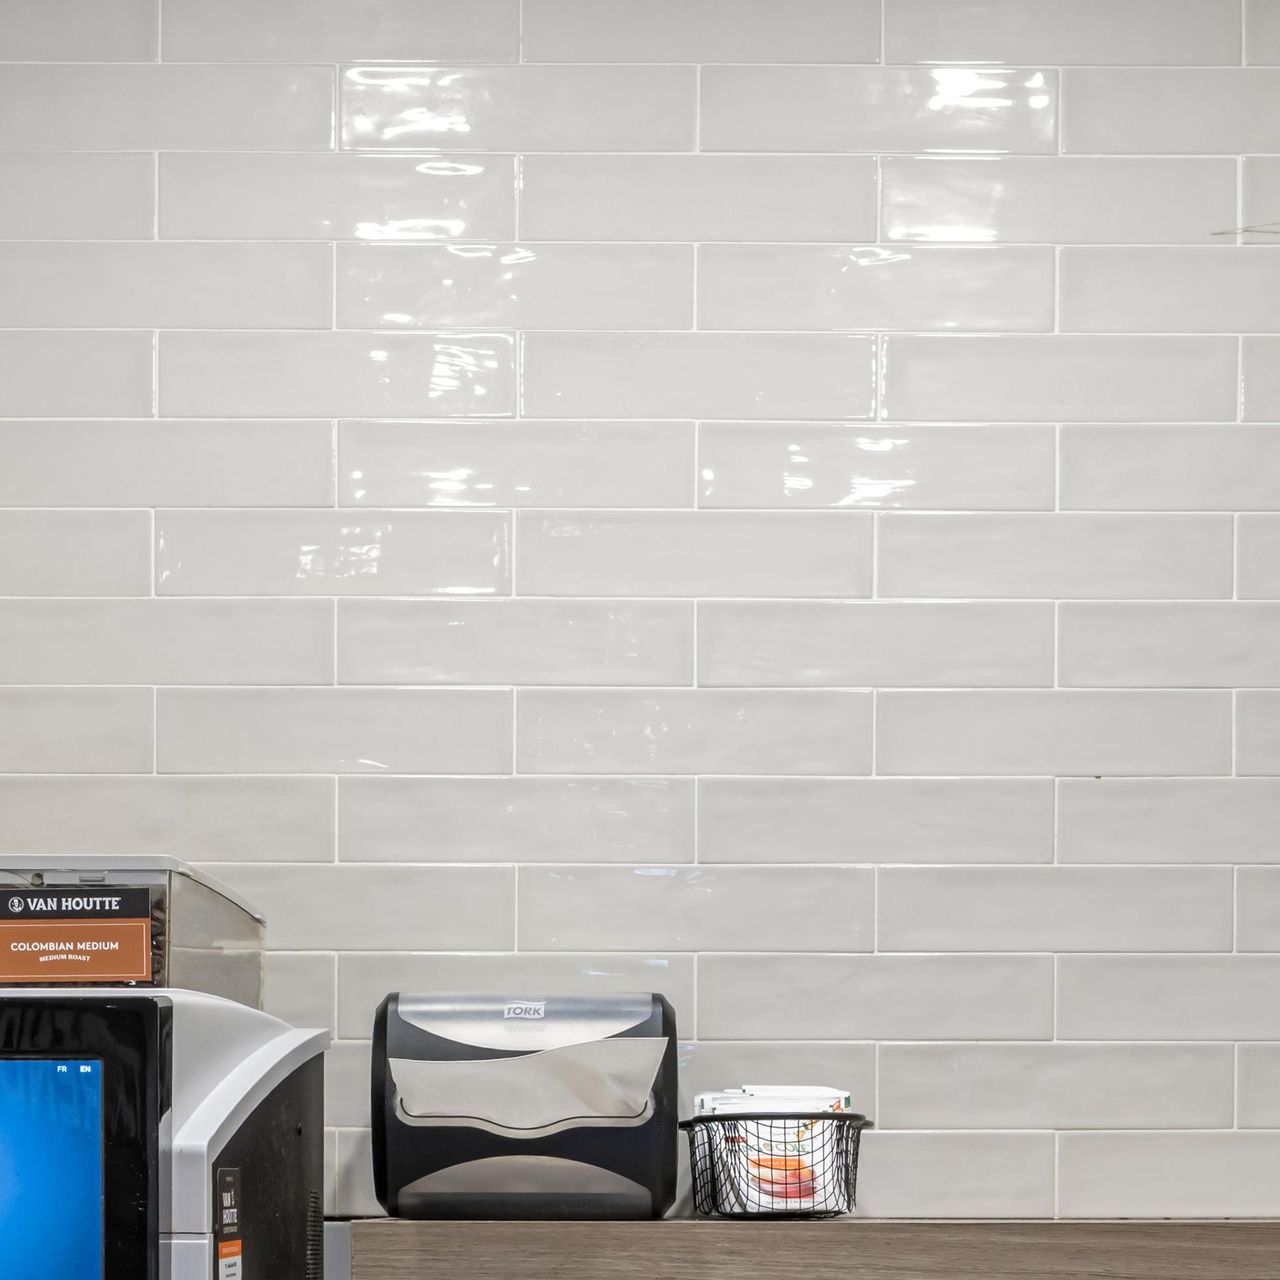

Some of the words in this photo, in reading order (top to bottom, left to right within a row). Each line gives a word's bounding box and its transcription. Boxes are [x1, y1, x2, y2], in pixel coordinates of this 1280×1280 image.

[27, 897, 57, 911] VAN
[61, 897, 120, 910] HOUTTE
[10, 942, 74, 951] COLOMBIAN
[77, 941, 119, 950] MEDIUM
[39, 954, 67, 962] MEDIUM
[68, 954, 91, 962] ROAST
[506, 1006, 543, 1016] TORK
[56, 1065, 68, 1073] FR
[79, 1065, 92, 1073] EN
